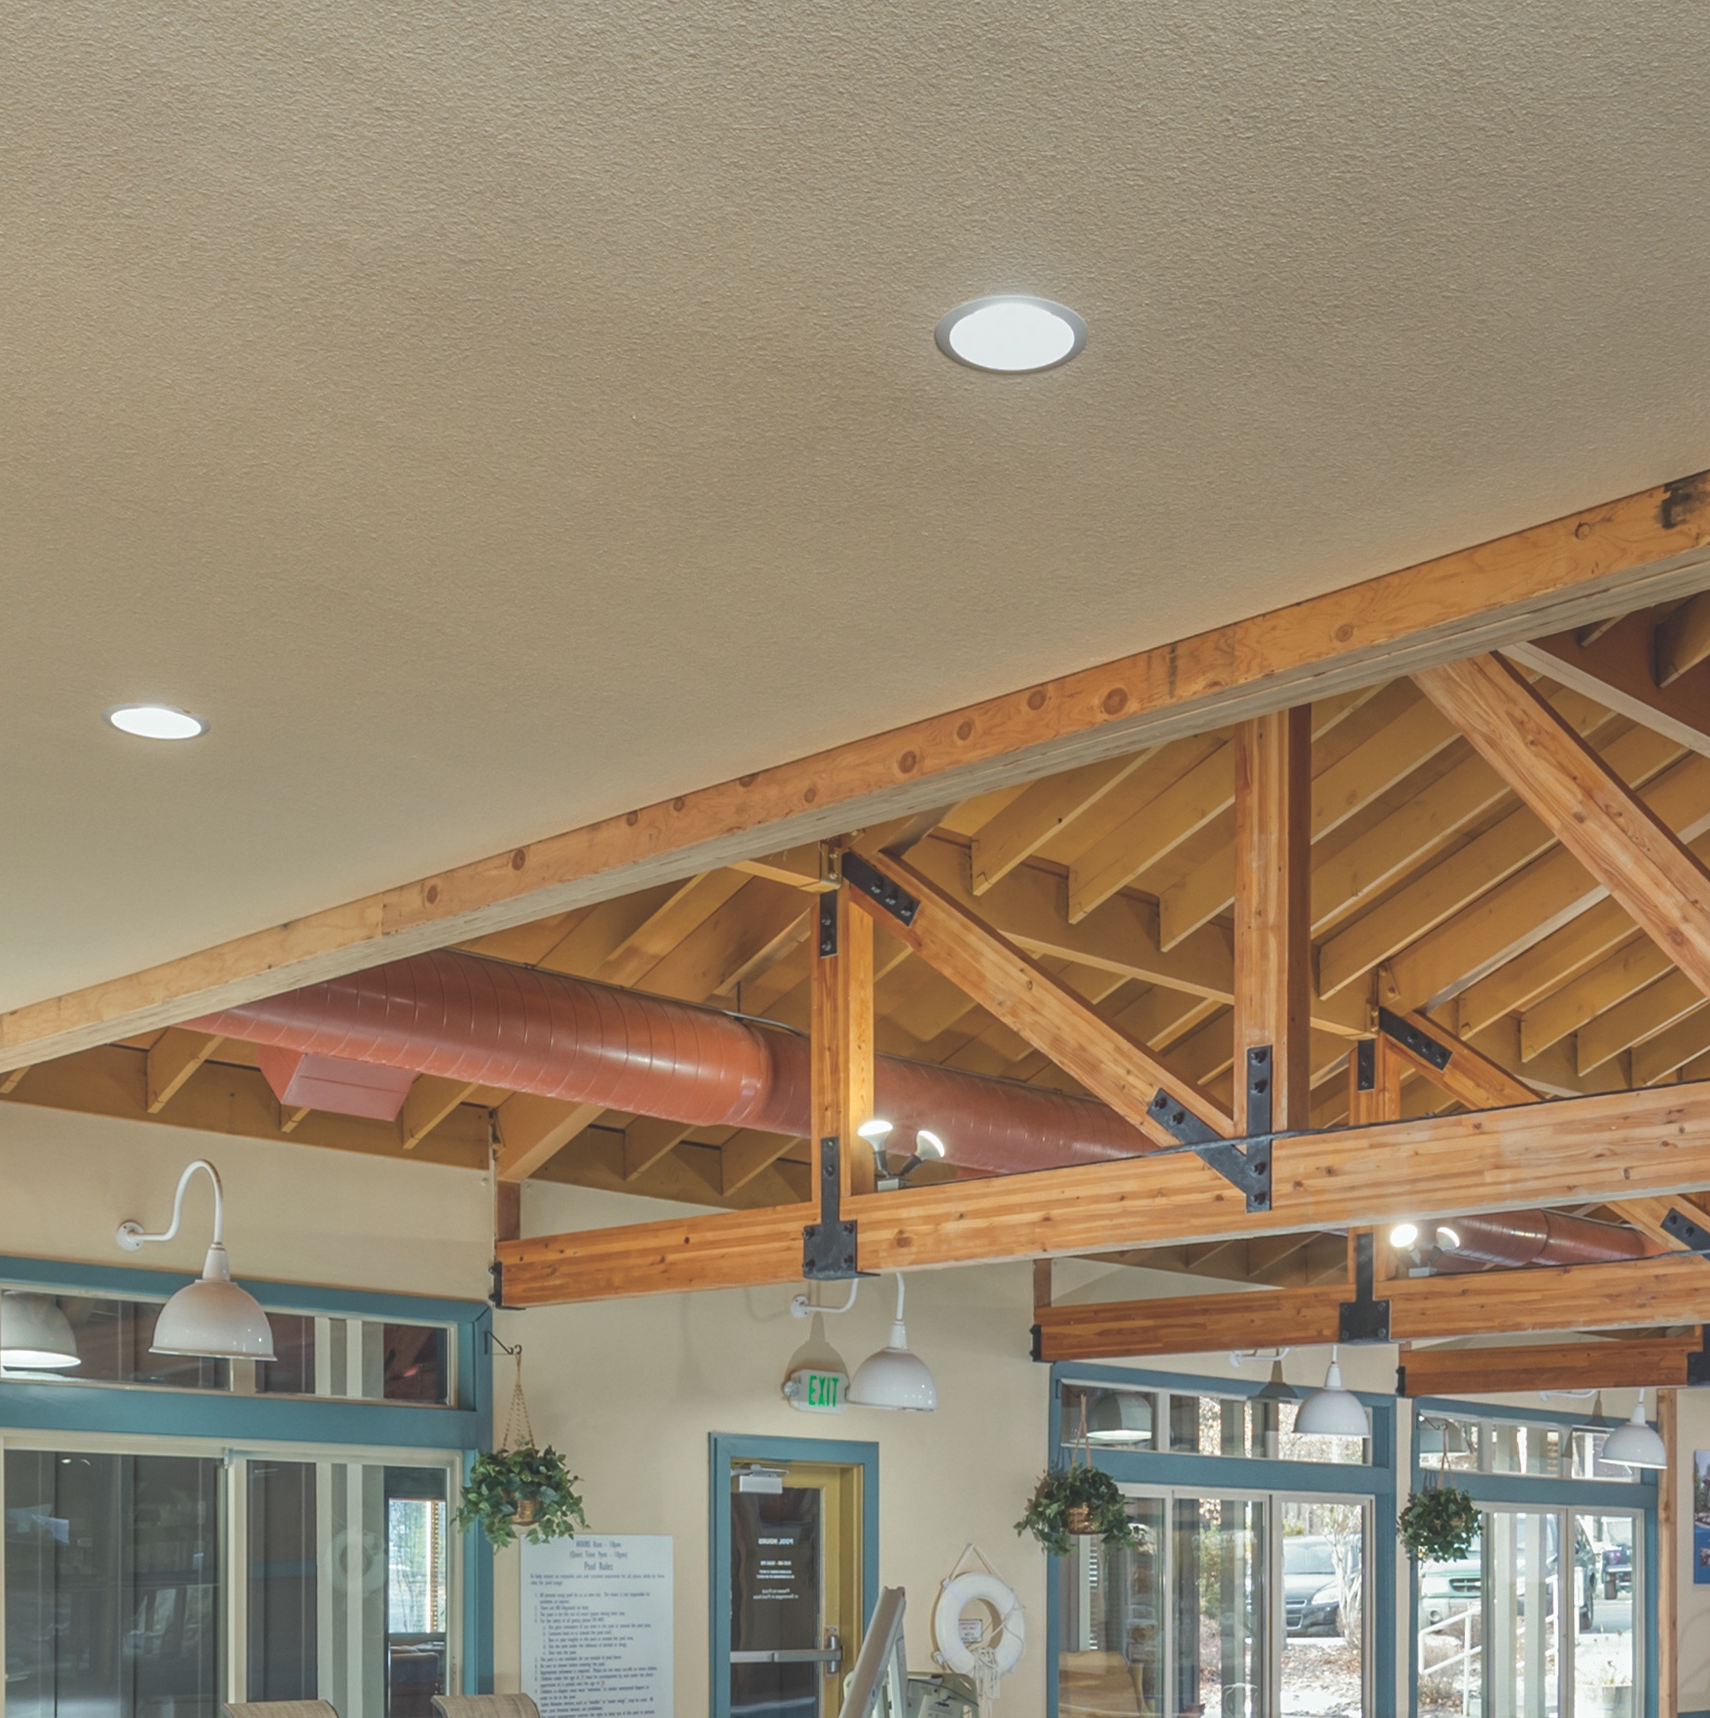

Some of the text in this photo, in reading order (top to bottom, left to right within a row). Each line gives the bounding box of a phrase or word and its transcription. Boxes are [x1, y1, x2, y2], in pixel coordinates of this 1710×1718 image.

[808, 1376, 839, 1407] EXIT
[576, 1540, 591, 1548] HOURS
[584, 1561, 613, 1571] Pool Rules
